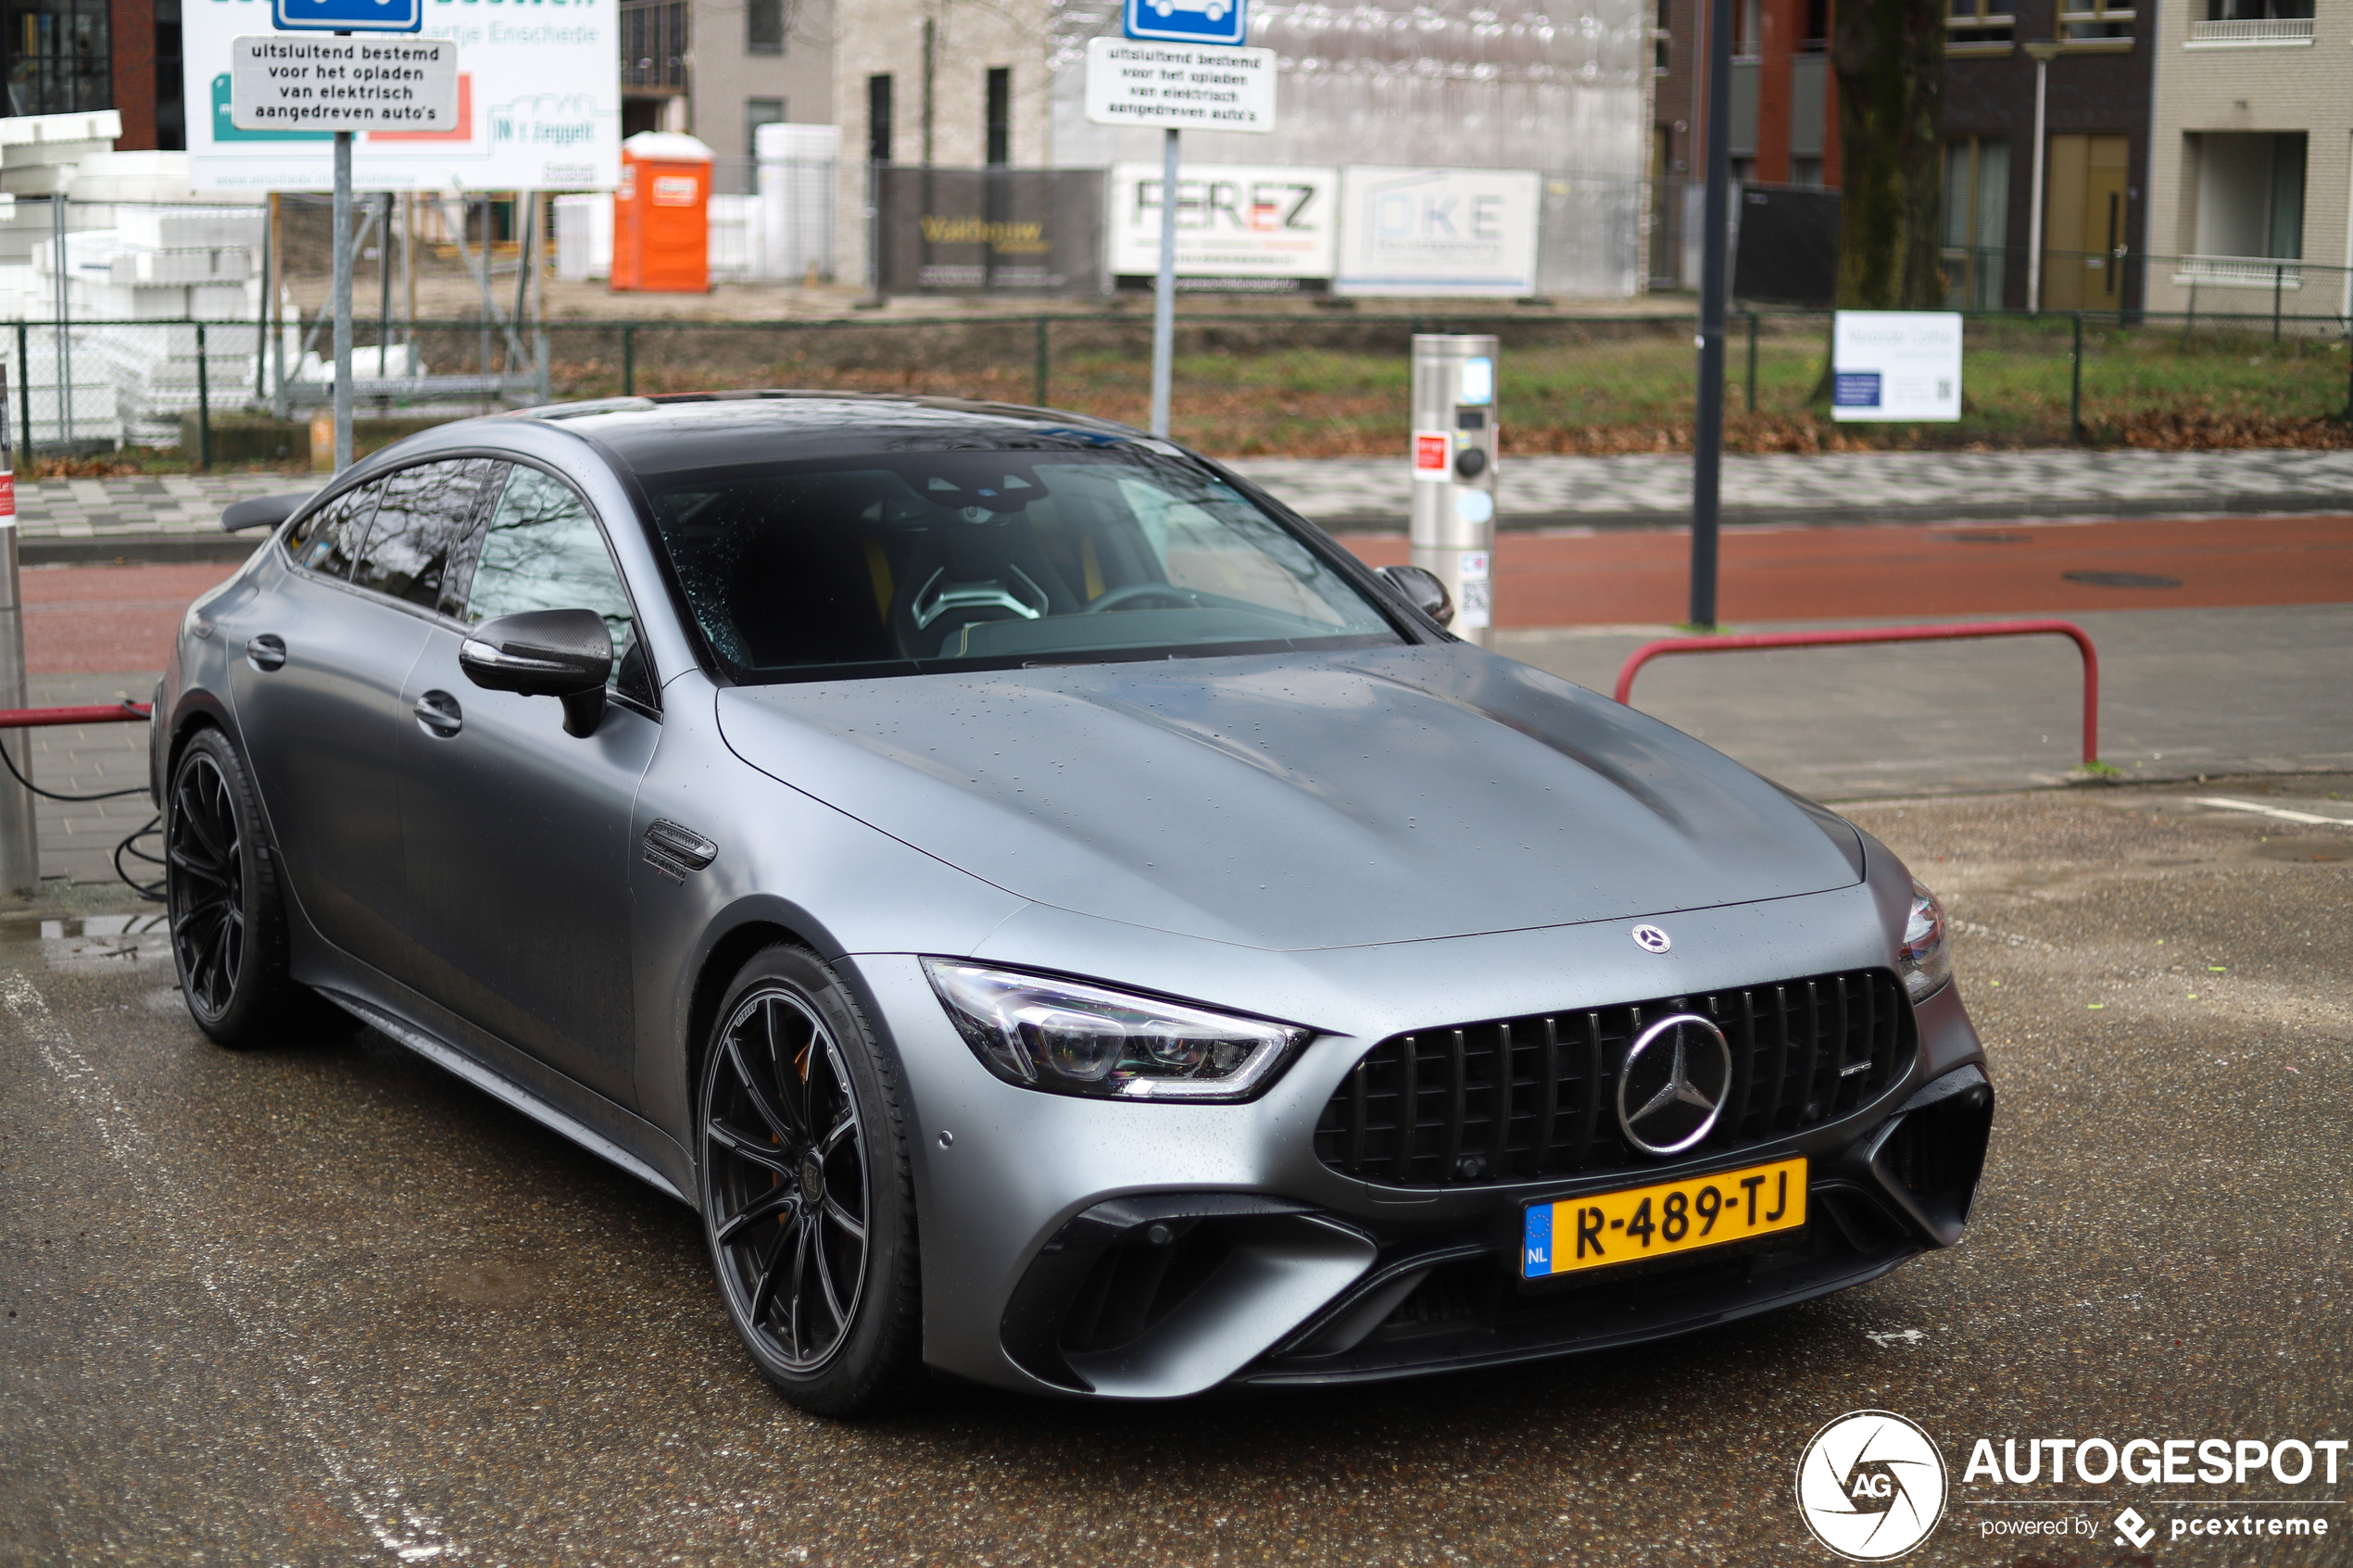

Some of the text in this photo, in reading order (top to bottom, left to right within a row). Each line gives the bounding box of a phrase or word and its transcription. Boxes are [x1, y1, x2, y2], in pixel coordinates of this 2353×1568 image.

[488, 20, 599, 44] Enschede
[252, 44, 440, 61] uitsluitend bestemd
[1108, 47, 1261, 69] uitsluitend bestemd
[269, 65, 424, 82] voor het opladen
[1121, 67, 1248, 86] voor het opladen
[280, 84, 413, 100] van elektrisch
[1128, 85, 1239, 103] van elektrisch
[256, 104, 436, 121] aangedreven auto's
[1108, 101, 1257, 121] aangedreven auto's
[1131, 178, 1319, 232] PEREZ
[1577, 1170, 1788, 1260] R-489-TJ
[1528, 1248, 1548, 1264] NL
